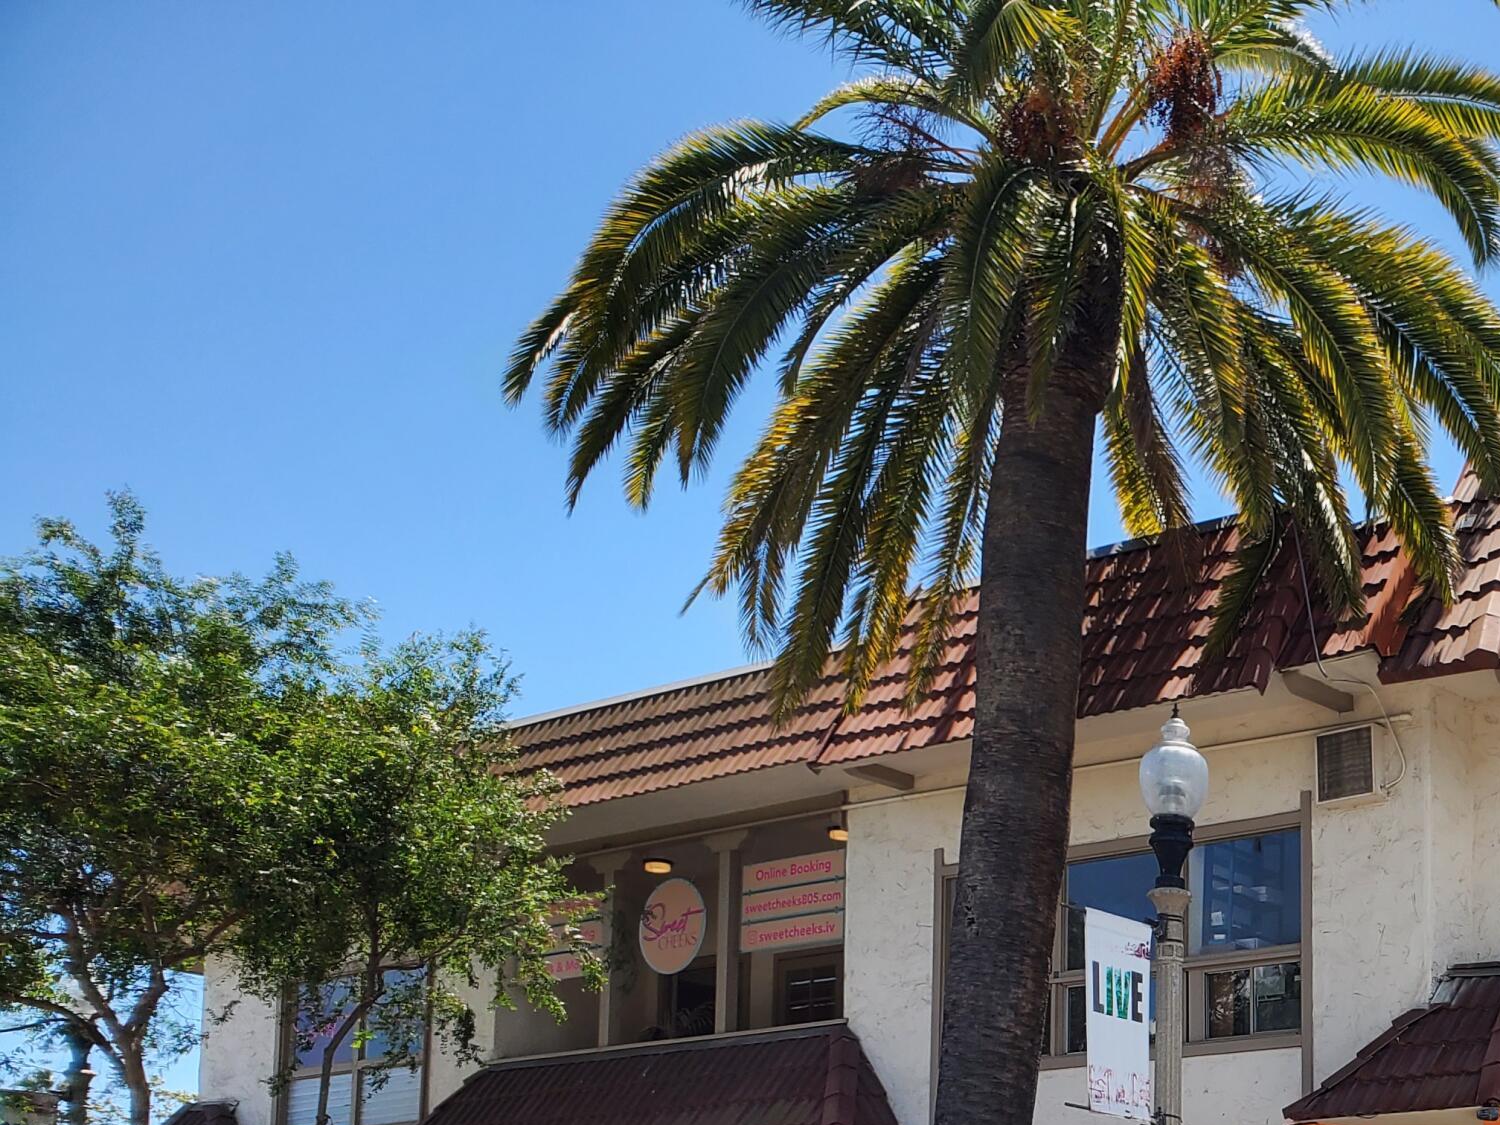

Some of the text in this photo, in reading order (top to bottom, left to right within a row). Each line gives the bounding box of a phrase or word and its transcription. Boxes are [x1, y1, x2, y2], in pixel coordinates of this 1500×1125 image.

[756, 860, 832, 881] Online Booking
[745, 891, 841, 914] sweetcheeks805.com
[642, 903, 705, 941] Sweet
[1092, 960, 1144, 1025] LIVE
